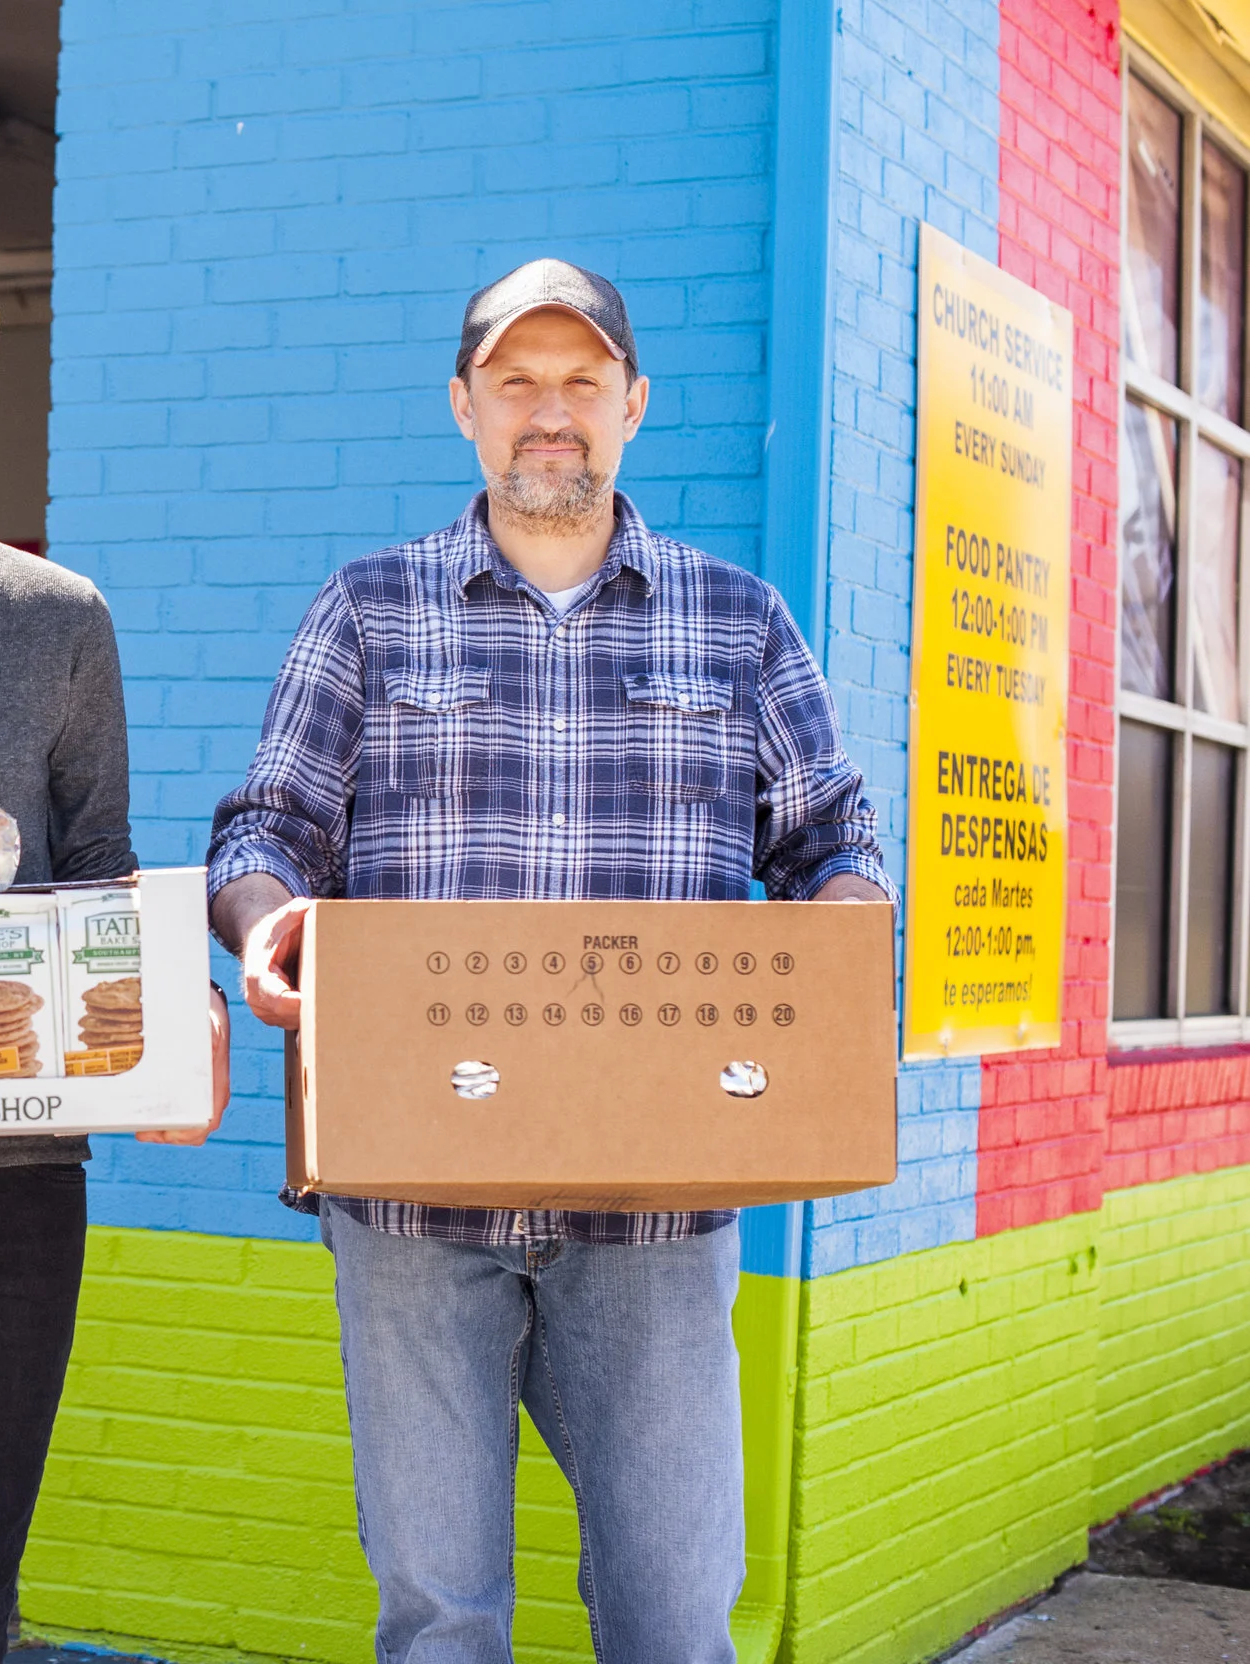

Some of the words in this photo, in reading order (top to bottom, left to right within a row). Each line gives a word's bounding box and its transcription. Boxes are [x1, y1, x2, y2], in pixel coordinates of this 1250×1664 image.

[933, 283, 999, 352] CHURCH
[1004, 323, 1063, 392] SERVICE
[970, 363, 1008, 411] 11:00
[1013, 388, 1034, 430] AM
[954, 420, 998, 467] EVERY
[1000, 441, 1046, 490] SUNDAY
[946, 524, 990, 578] FOOD
[997, 546, 1050, 599] PANTRY
[951, 587, 1026, 647] 12:00-1:00
[1030, 612, 1048, 654] PM
[947, 653, 991, 694] EVERY
[996, 665, 1046, 707] TUESDAY
[938, 751, 1027, 803] ENTREGA
[1032, 764, 1050, 806] DE
[941, 812, 1048, 862] DESPENSAS
[954, 878, 986, 908] cada
[991, 877, 1033, 908] Martes
[583, 936, 638, 949] PACKER
[945, 925, 1012, 956] 12:00-1:00
[430, 1007, 445, 1021] 11
[469, 1007, 485, 1021] 12
[507, 1007, 524, 1021] 13
[545, 1007, 562, 1021] 14
[584, 1007, 600, 1021] 15
[622, 1007, 639, 1021] 16
[660, 1007, 677, 1021] 17
[698, 1007, 716, 1022] 18
[737, 1007, 754, 1022] 19
[775, 1007, 792, 1022] 20
[944, 977, 957, 1006] te
